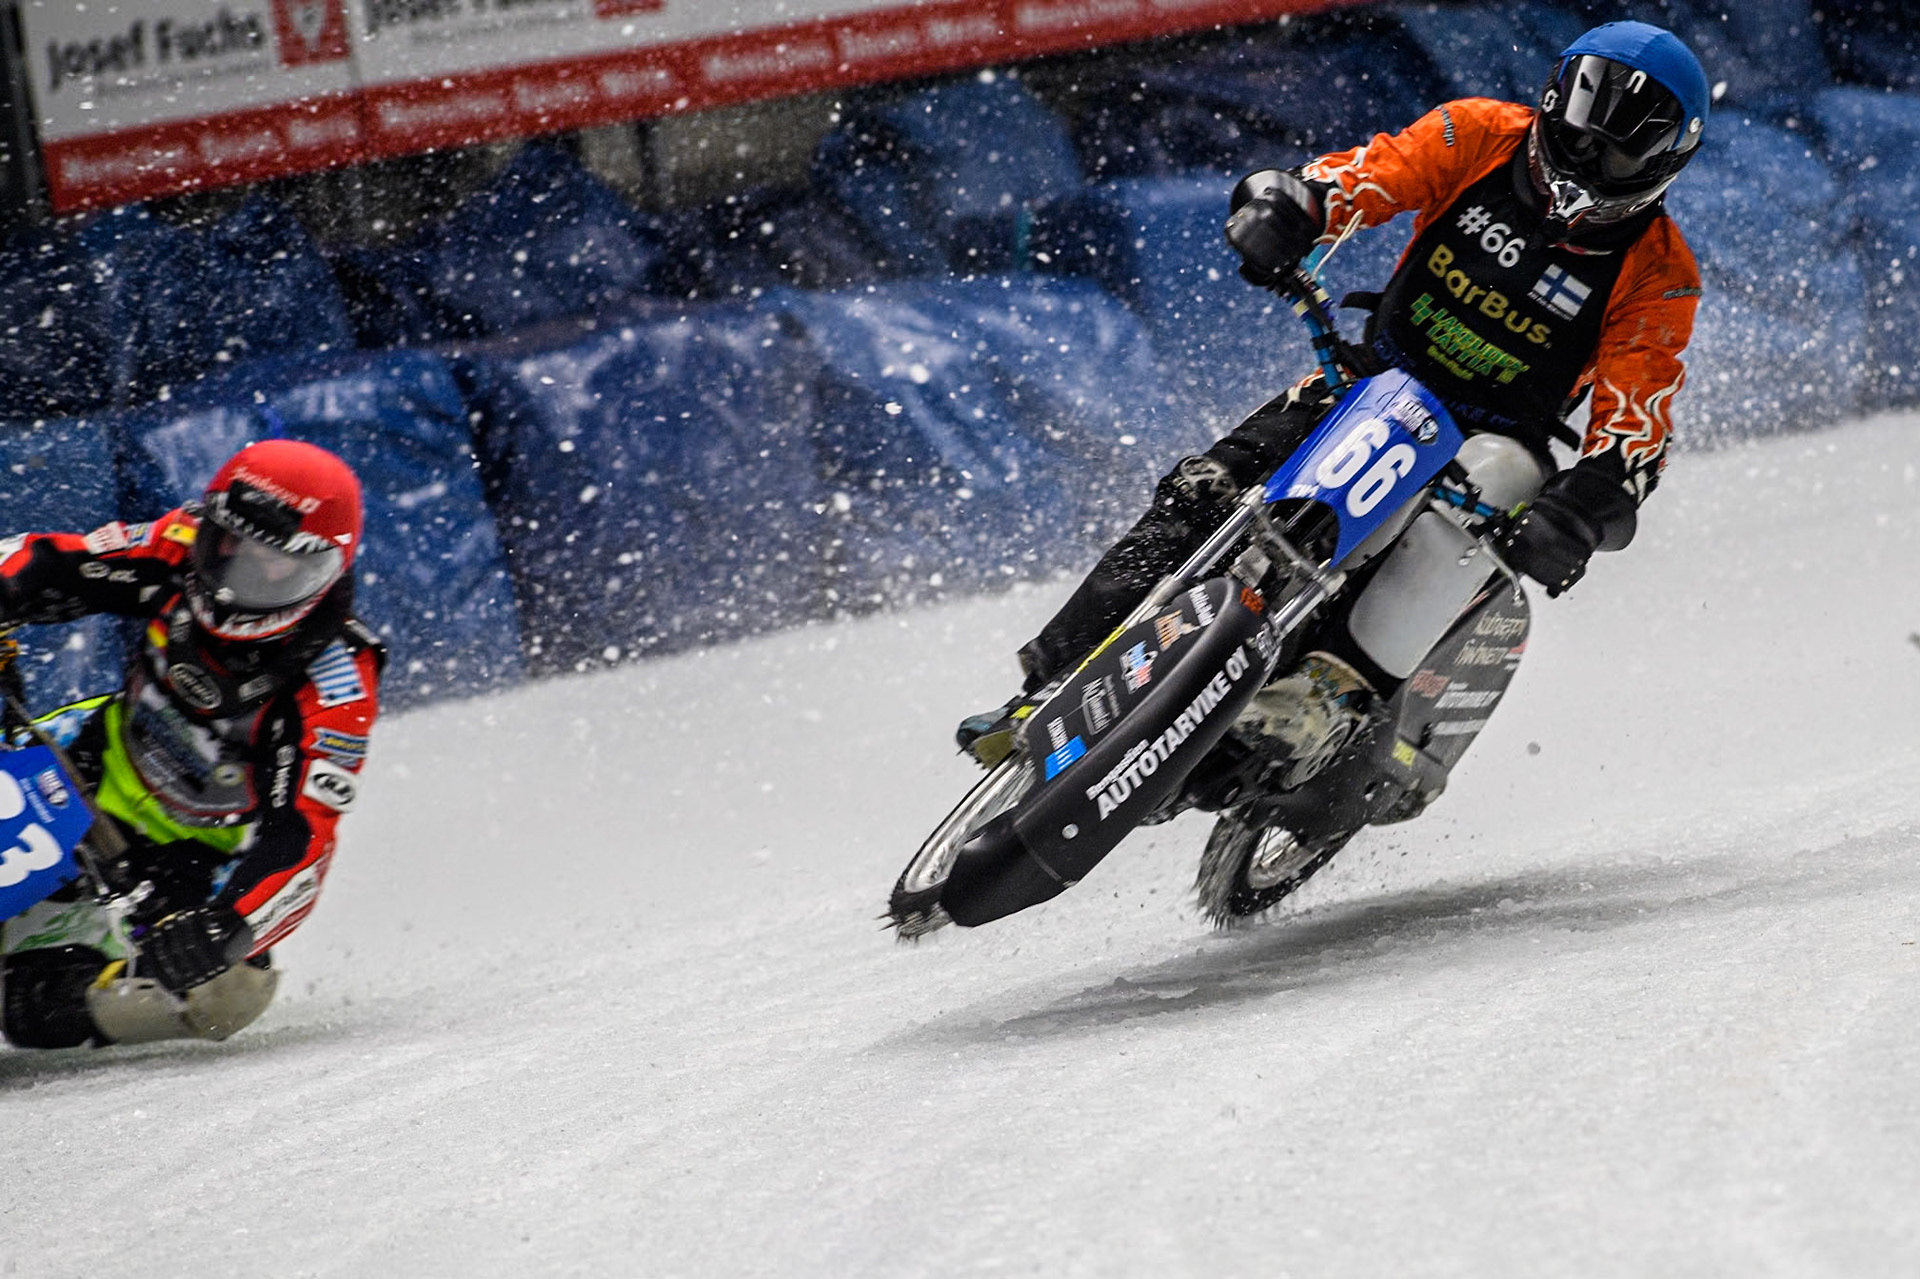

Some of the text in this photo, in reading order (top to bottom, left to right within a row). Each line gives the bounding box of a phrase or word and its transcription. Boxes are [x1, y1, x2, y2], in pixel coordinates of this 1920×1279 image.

[1456, 205, 1526, 268] #66
[1427, 243, 1551, 344] BarBus
[1316, 417, 1417, 518] 66
[1097, 669, 1233, 821] AUTOTARVIKE
[1225, 645, 1250, 682] OY
